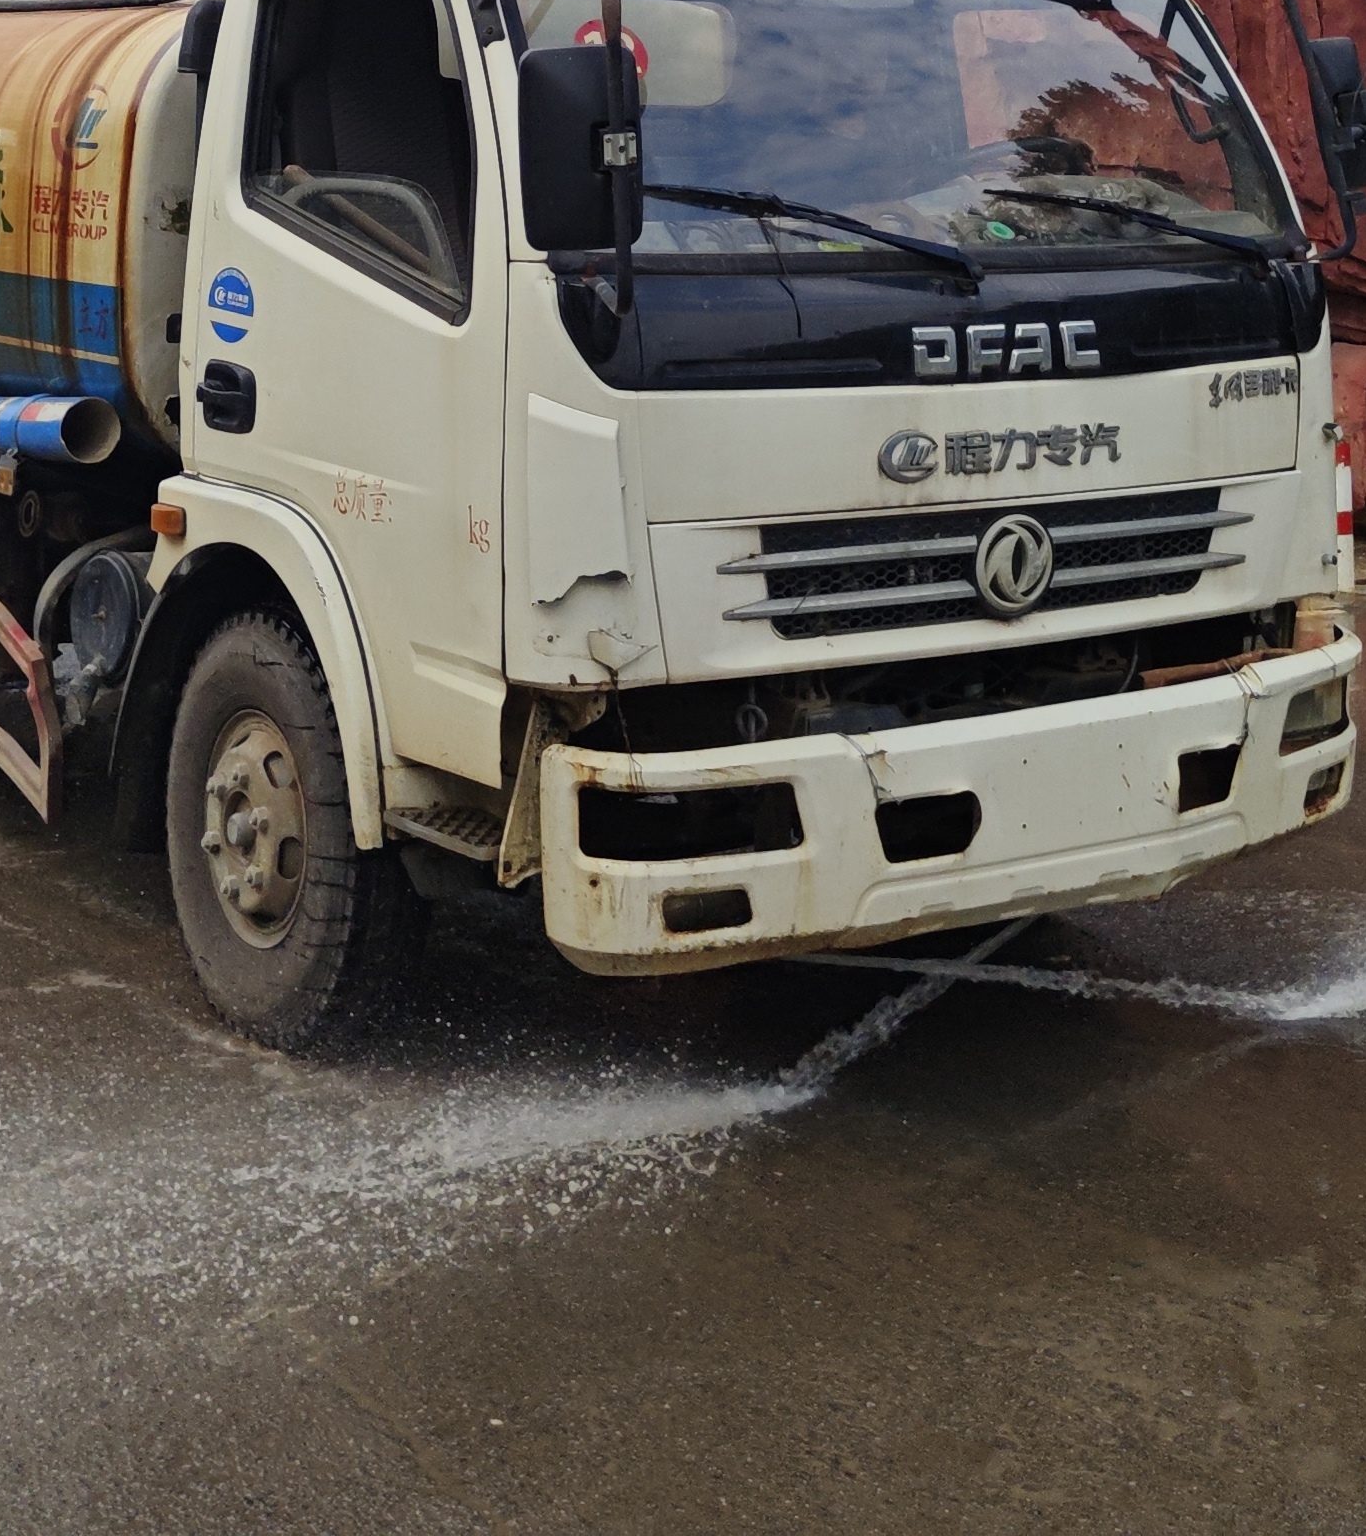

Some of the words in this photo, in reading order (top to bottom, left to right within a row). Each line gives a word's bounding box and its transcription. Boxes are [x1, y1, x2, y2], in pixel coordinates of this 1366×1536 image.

[911, 319, 1101, 378] DFAC
[944, 422, 1123, 477] 程力专汽
[467, 504, 491, 554] kg
